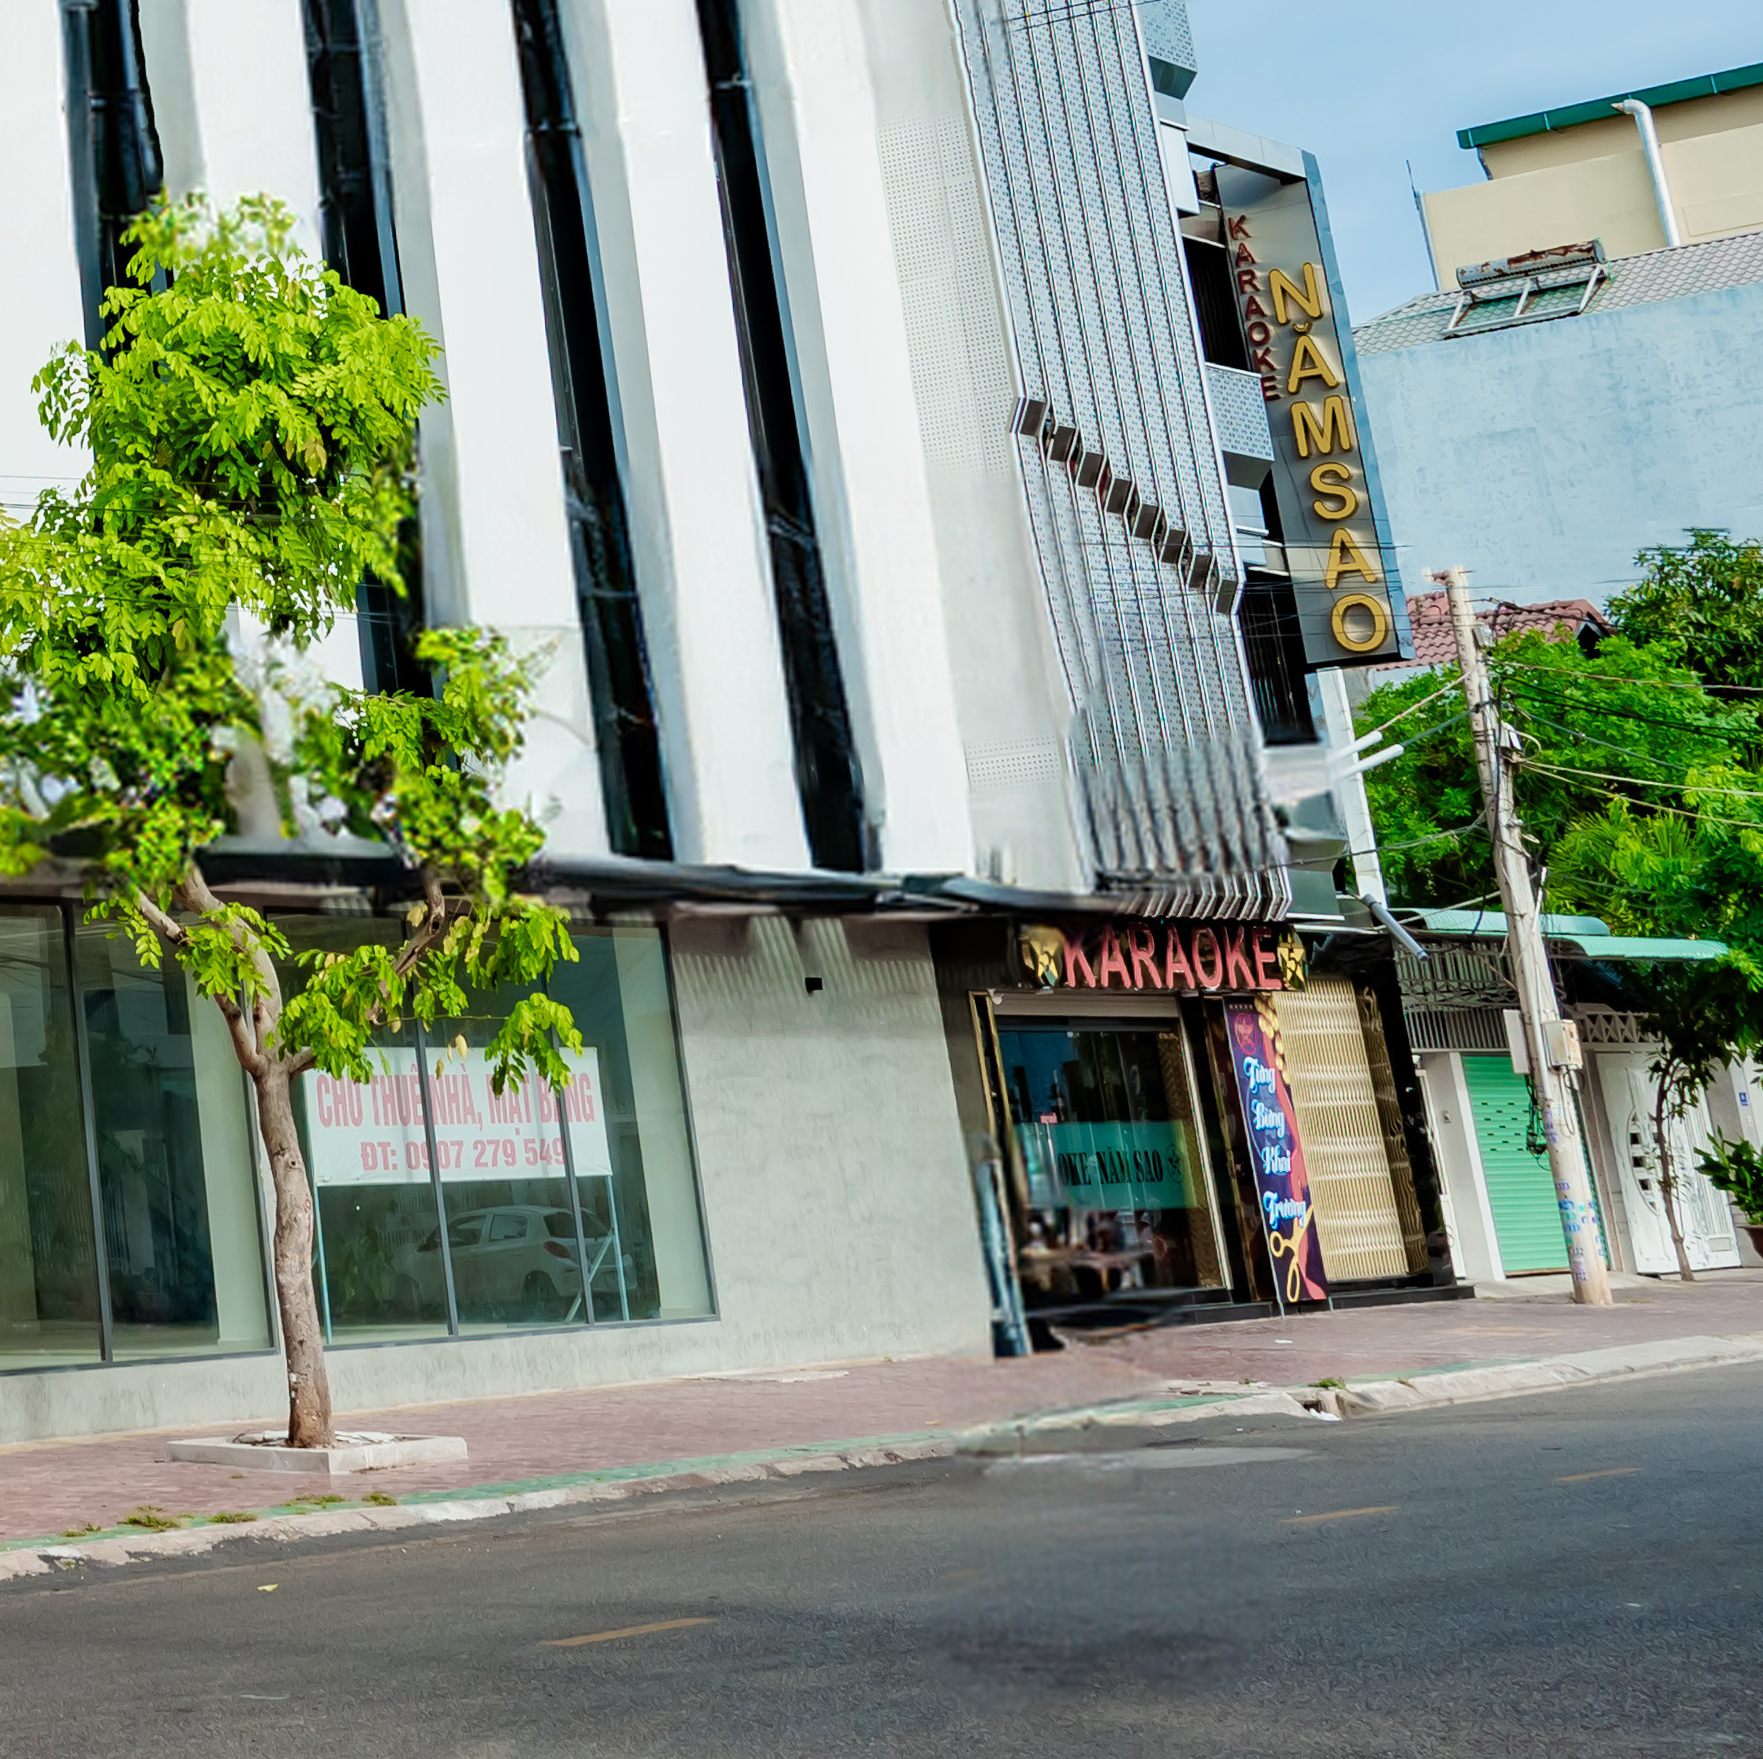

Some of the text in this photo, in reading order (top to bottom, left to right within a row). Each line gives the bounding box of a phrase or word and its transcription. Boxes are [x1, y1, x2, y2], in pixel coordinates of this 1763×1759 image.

[1227, 213, 1280, 404] KARAOKE
[1063, 922, 1283, 989] KARAOKE
[316, 1073, 364, 1129] CHO
[536, 1072, 596, 1126] BNG
[360, 1141, 399, 1171] ĐT:
[472, 1138, 517, 1168] 279
[522, 1136, 566, 1166] 549
[1262, 1144, 1291, 1175] Khai
